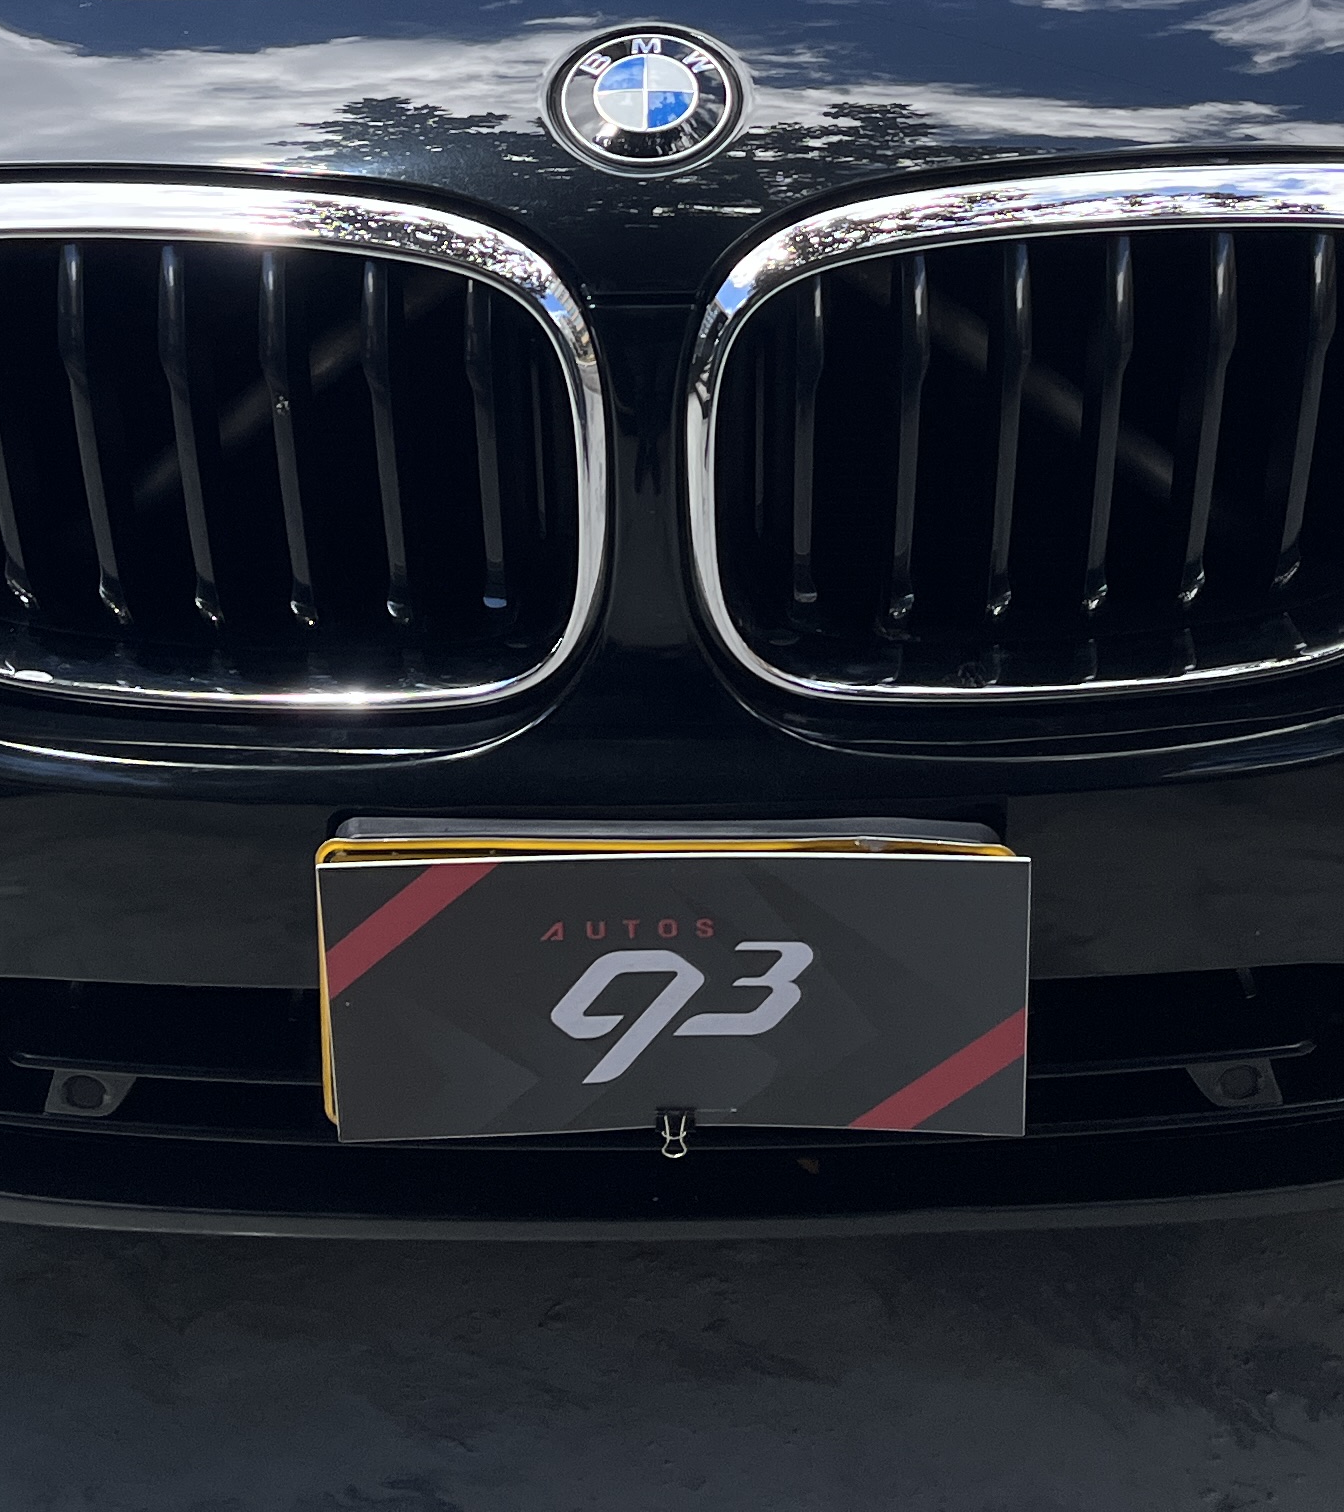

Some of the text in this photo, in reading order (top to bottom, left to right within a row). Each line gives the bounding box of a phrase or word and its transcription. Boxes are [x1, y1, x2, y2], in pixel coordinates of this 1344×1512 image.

[578, 37, 716, 76] BMW
[540, 918, 716, 942] AUTOS
[550, 941, 814, 1085] 93
